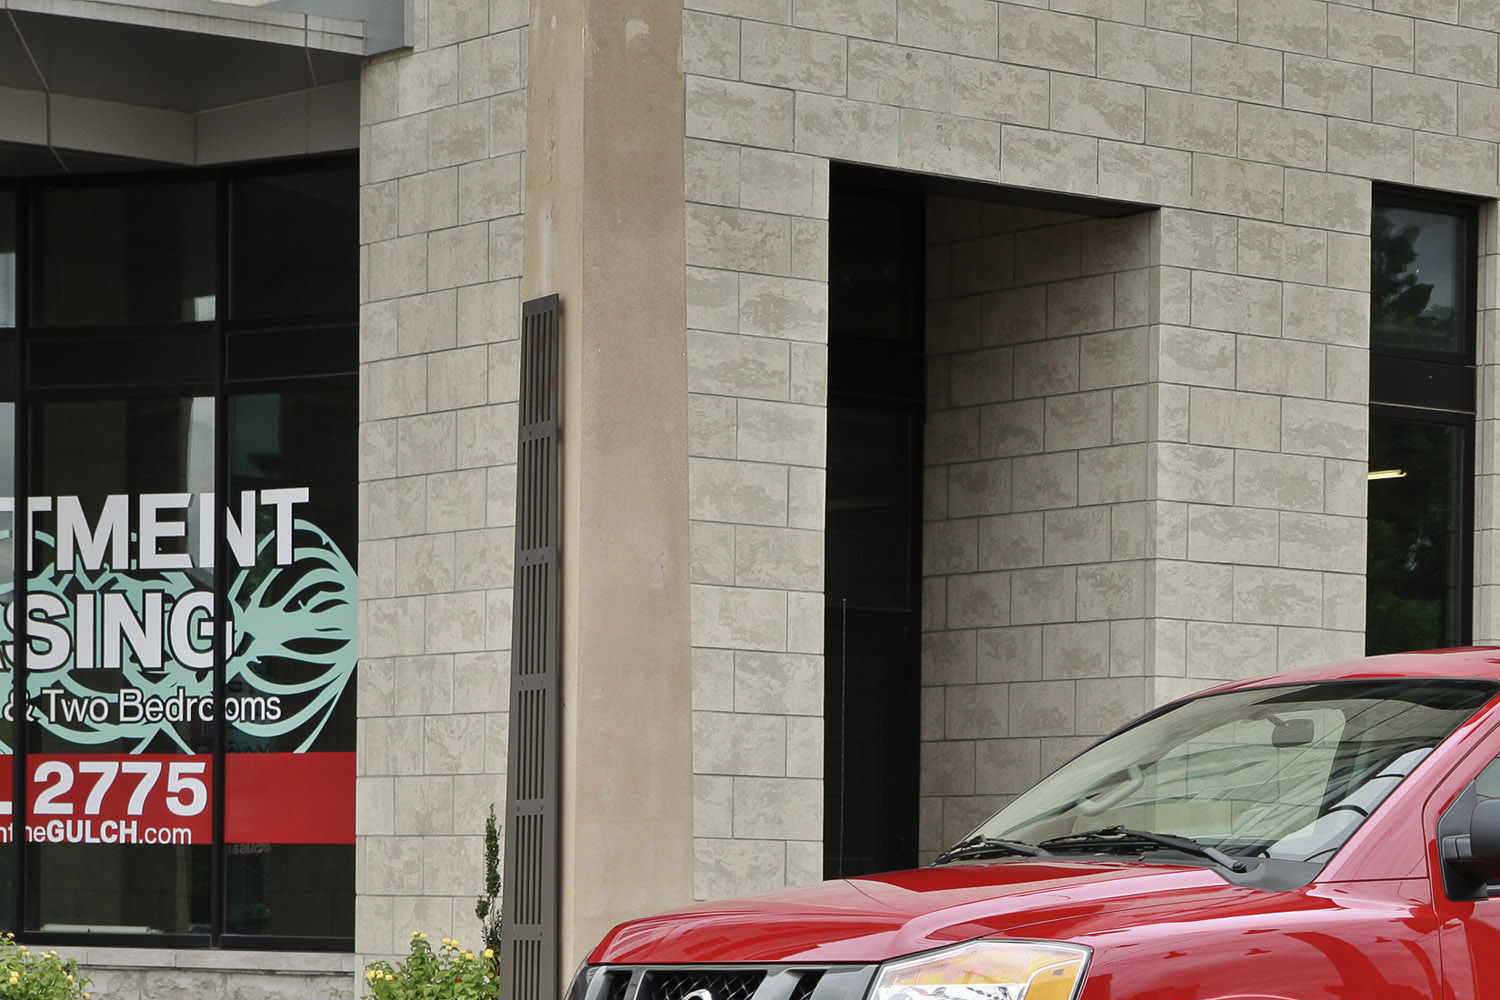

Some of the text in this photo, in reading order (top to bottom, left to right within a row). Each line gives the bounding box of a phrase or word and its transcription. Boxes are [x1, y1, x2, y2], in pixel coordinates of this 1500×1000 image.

[0, 590, 233, 670] SING
[42, 689, 109, 723] Two
[119, 687, 282, 723] Bedrooms
